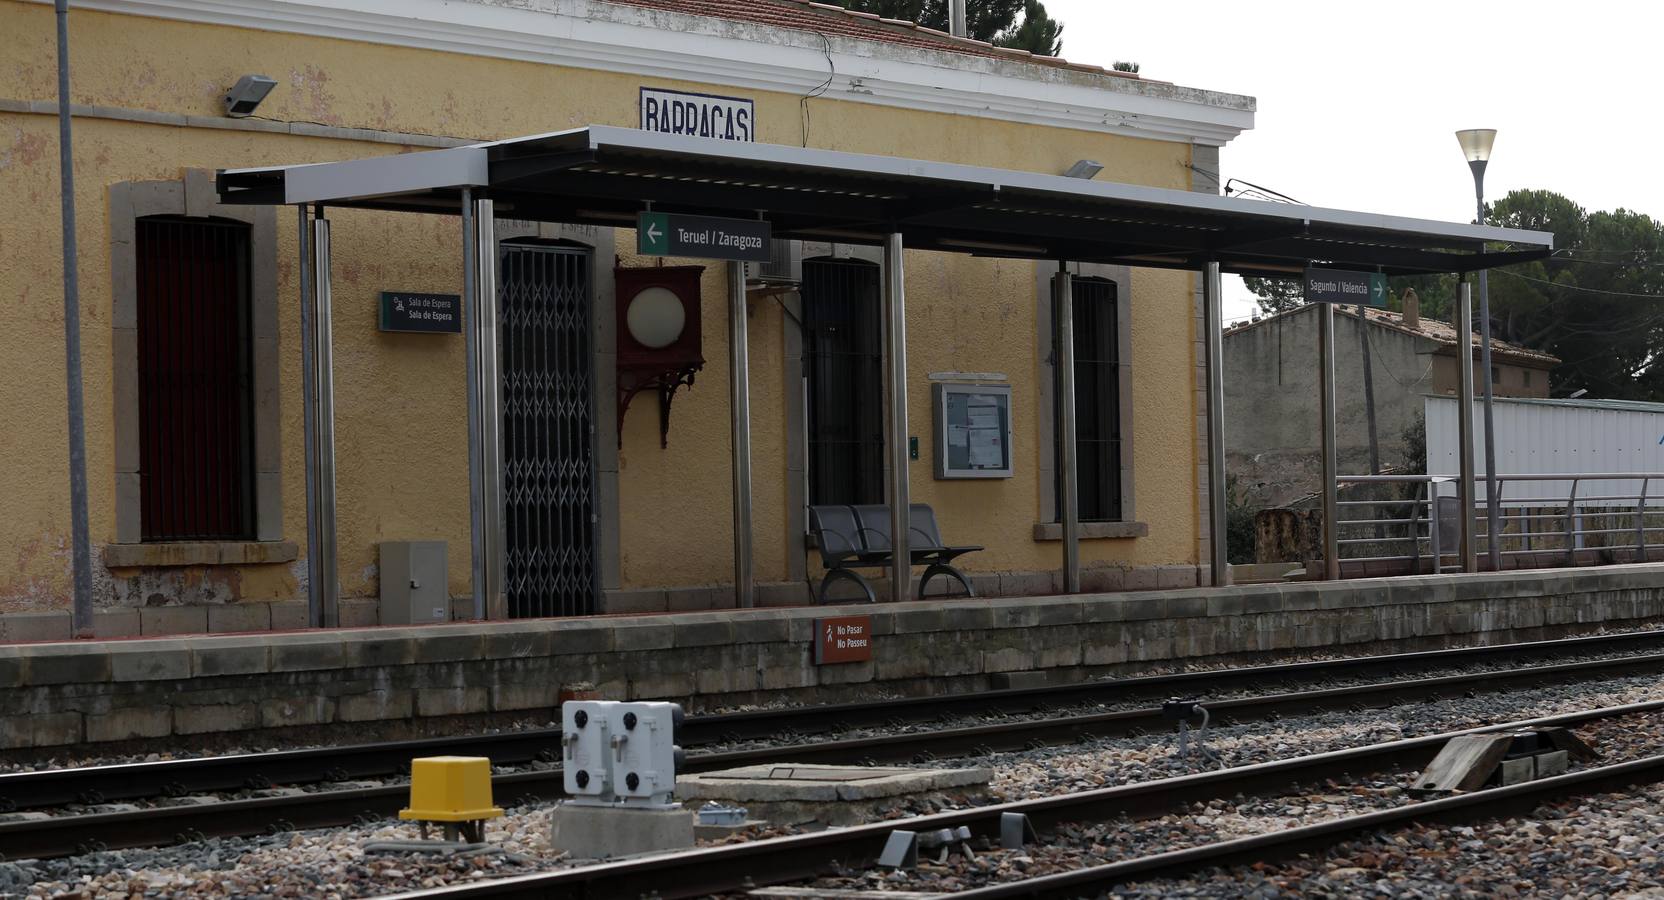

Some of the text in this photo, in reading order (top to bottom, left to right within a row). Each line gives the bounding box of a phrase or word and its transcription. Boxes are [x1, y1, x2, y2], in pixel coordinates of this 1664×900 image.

[678, 228, 762, 250] Teruel / Zaragoza
[1310, 279, 1337, 294] Sagunto
[1341, 281, 1368, 294] Valencia
[408, 297, 451, 309] Sala de Espera
[409, 310, 452, 322] Sala de Espera
[837, 625, 863, 635] No Pasar
[837, 638, 868, 648] No Passeu
